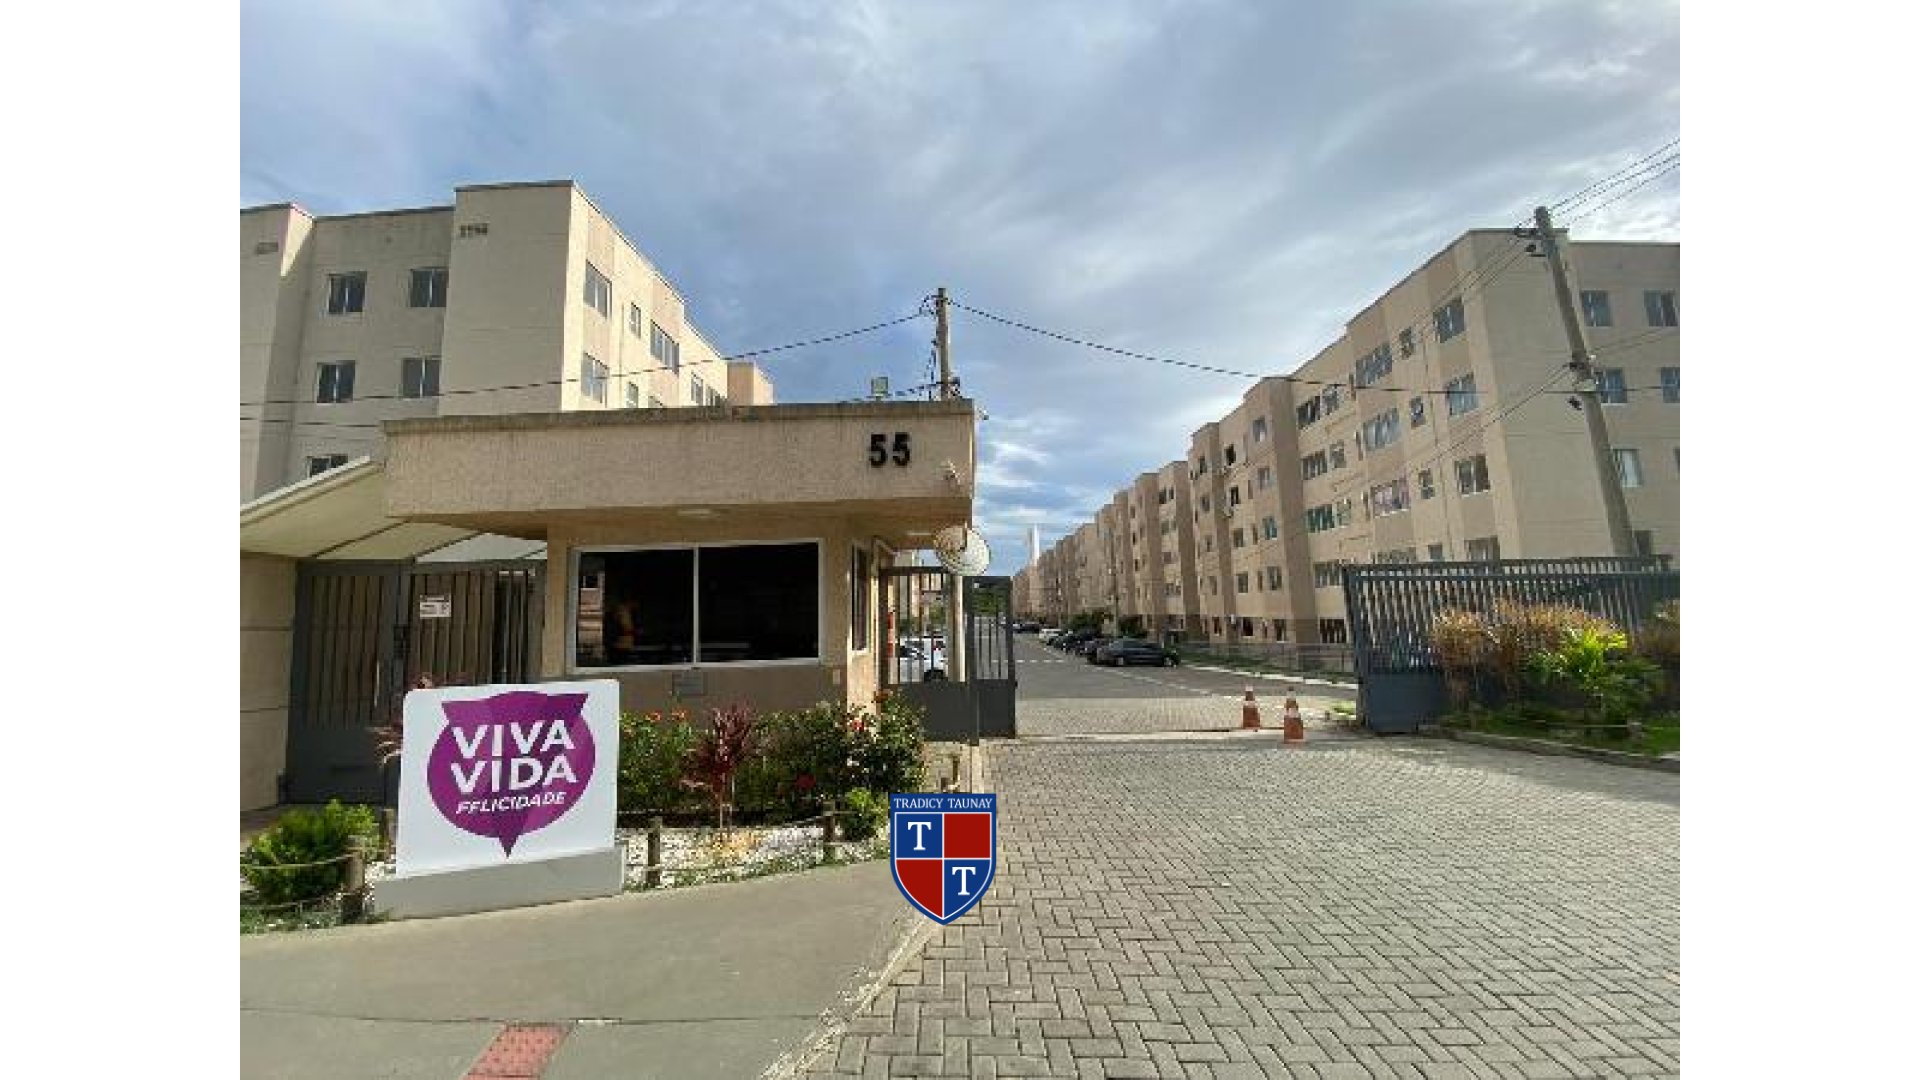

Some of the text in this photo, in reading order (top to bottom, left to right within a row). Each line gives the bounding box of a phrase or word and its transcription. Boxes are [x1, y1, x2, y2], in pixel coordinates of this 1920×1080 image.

[868, 431, 911, 468] 55
[451, 719, 576, 759] VIVA
[450, 754, 578, 793] VIDA
